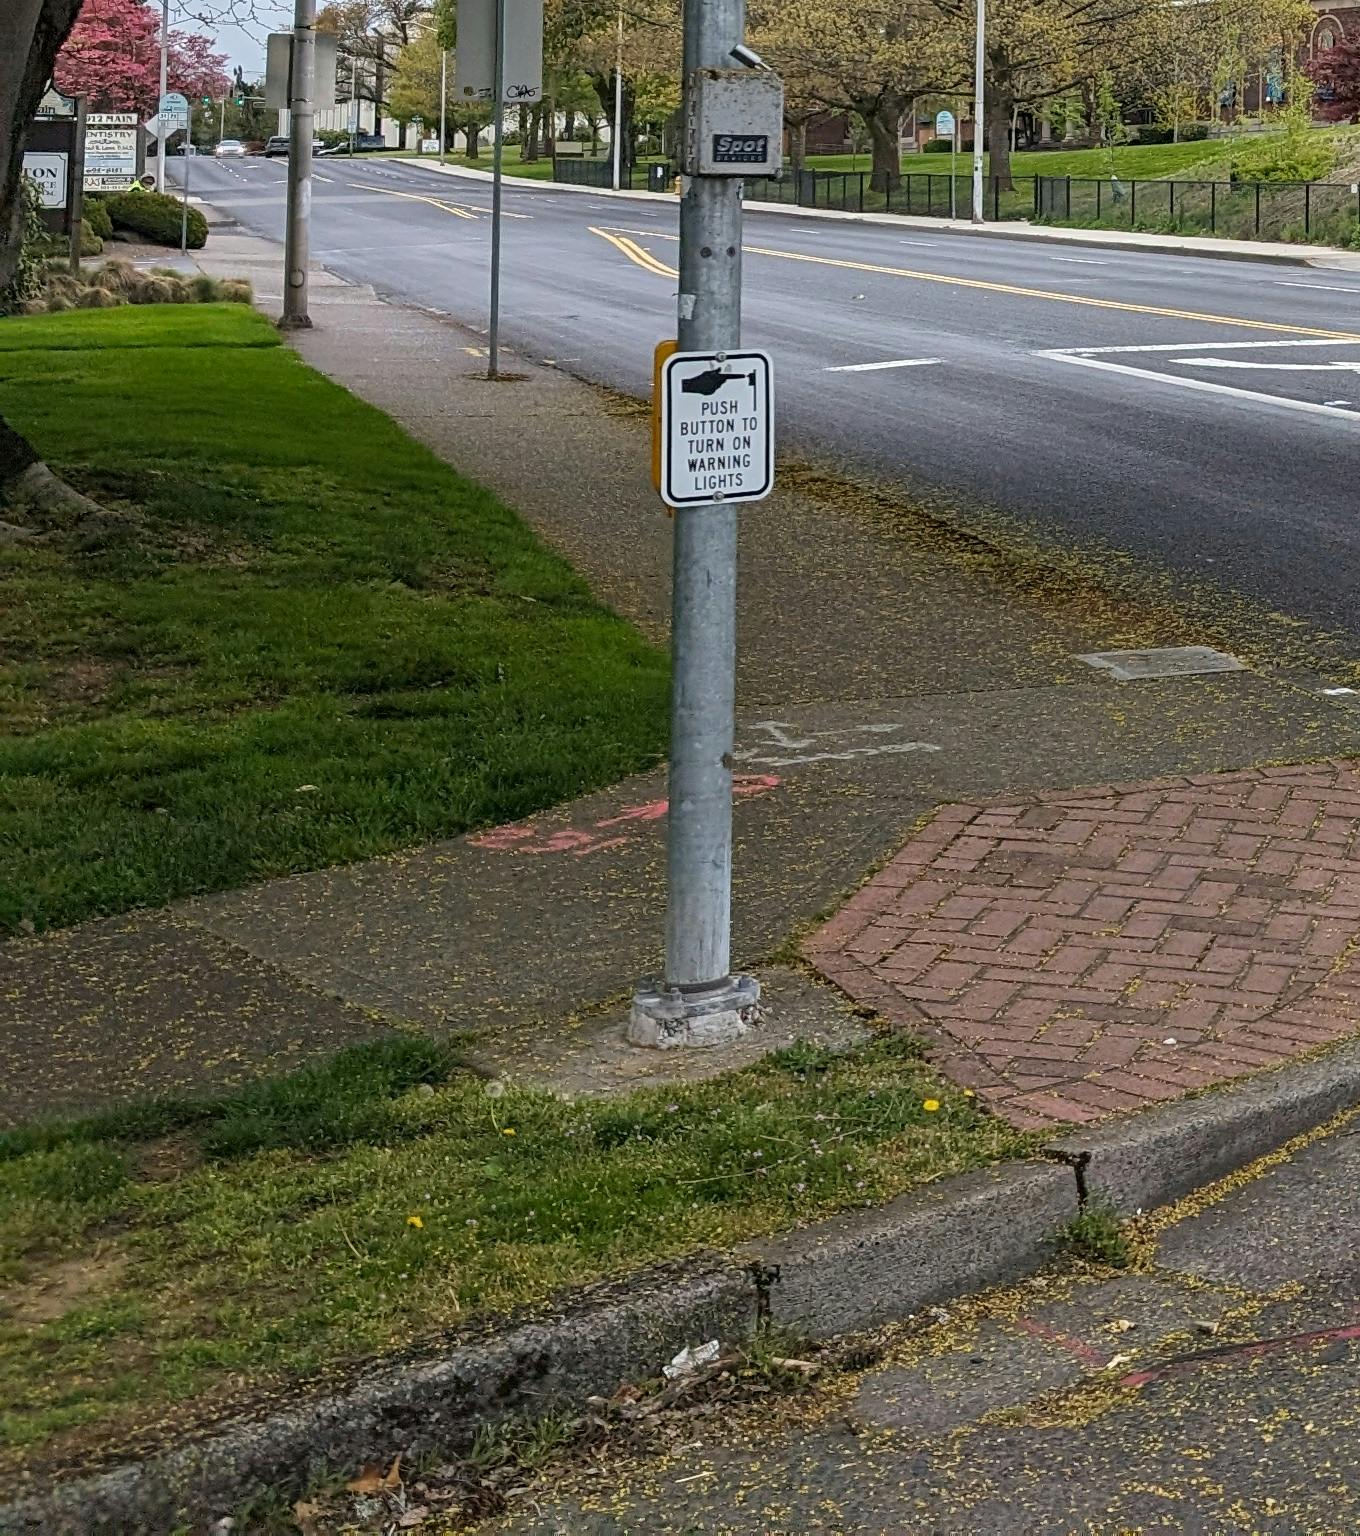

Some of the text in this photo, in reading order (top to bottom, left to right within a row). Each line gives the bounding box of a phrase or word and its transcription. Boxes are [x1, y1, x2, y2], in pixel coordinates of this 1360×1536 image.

[38, 105, 55, 114] ain
[106, 115, 133, 123] MAIN
[717, 136, 766, 154] Spot
[24, 167, 58, 179] TON
[701, 400, 738, 416] PUSH
[680, 417, 758, 436] BUTTON TO
[688, 435, 751, 454] TURN ON
[687, 454, 751, 473] WARNING
[694, 472, 743, 491] LIGHTS
